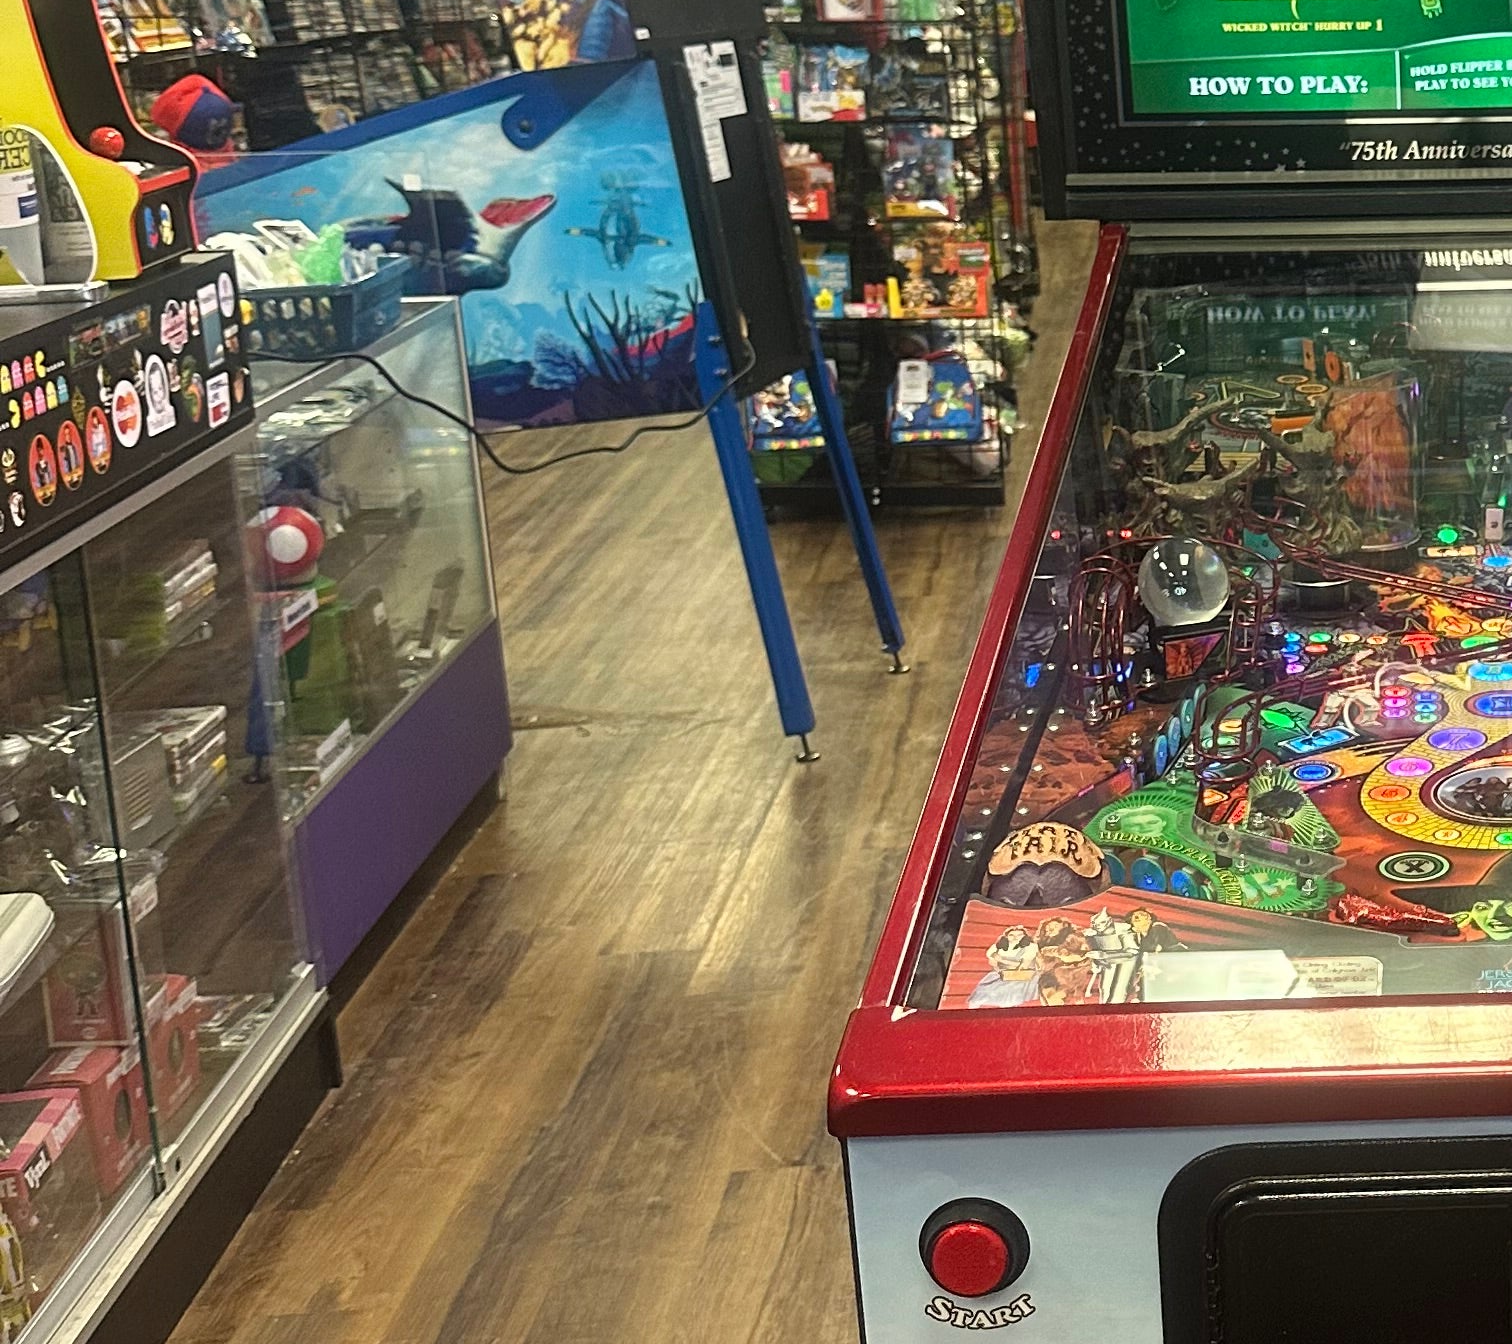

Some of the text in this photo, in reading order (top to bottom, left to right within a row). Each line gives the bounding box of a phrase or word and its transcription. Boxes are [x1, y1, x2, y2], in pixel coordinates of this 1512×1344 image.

[1222, 22, 1268, 32] WICKED
[1270, 22, 1309, 32] WITCH
[1314, 21, 1353, 31] HURRY
[1356, 21, 1371, 31] UP
[1410, 64, 1447, 77] HOLD
[1450, 61, 1503, 74] FLIPPER
[1189, 76, 1369, 96] HOW TO PLAY:
[1415, 79, 1448, 91] PLAY
[1451, 78, 1470, 89] TO
[1473, 77, 1498, 88] SEE
[1160, 840, 1184, 852] NO
[924, 1293, 1038, 1331] START
